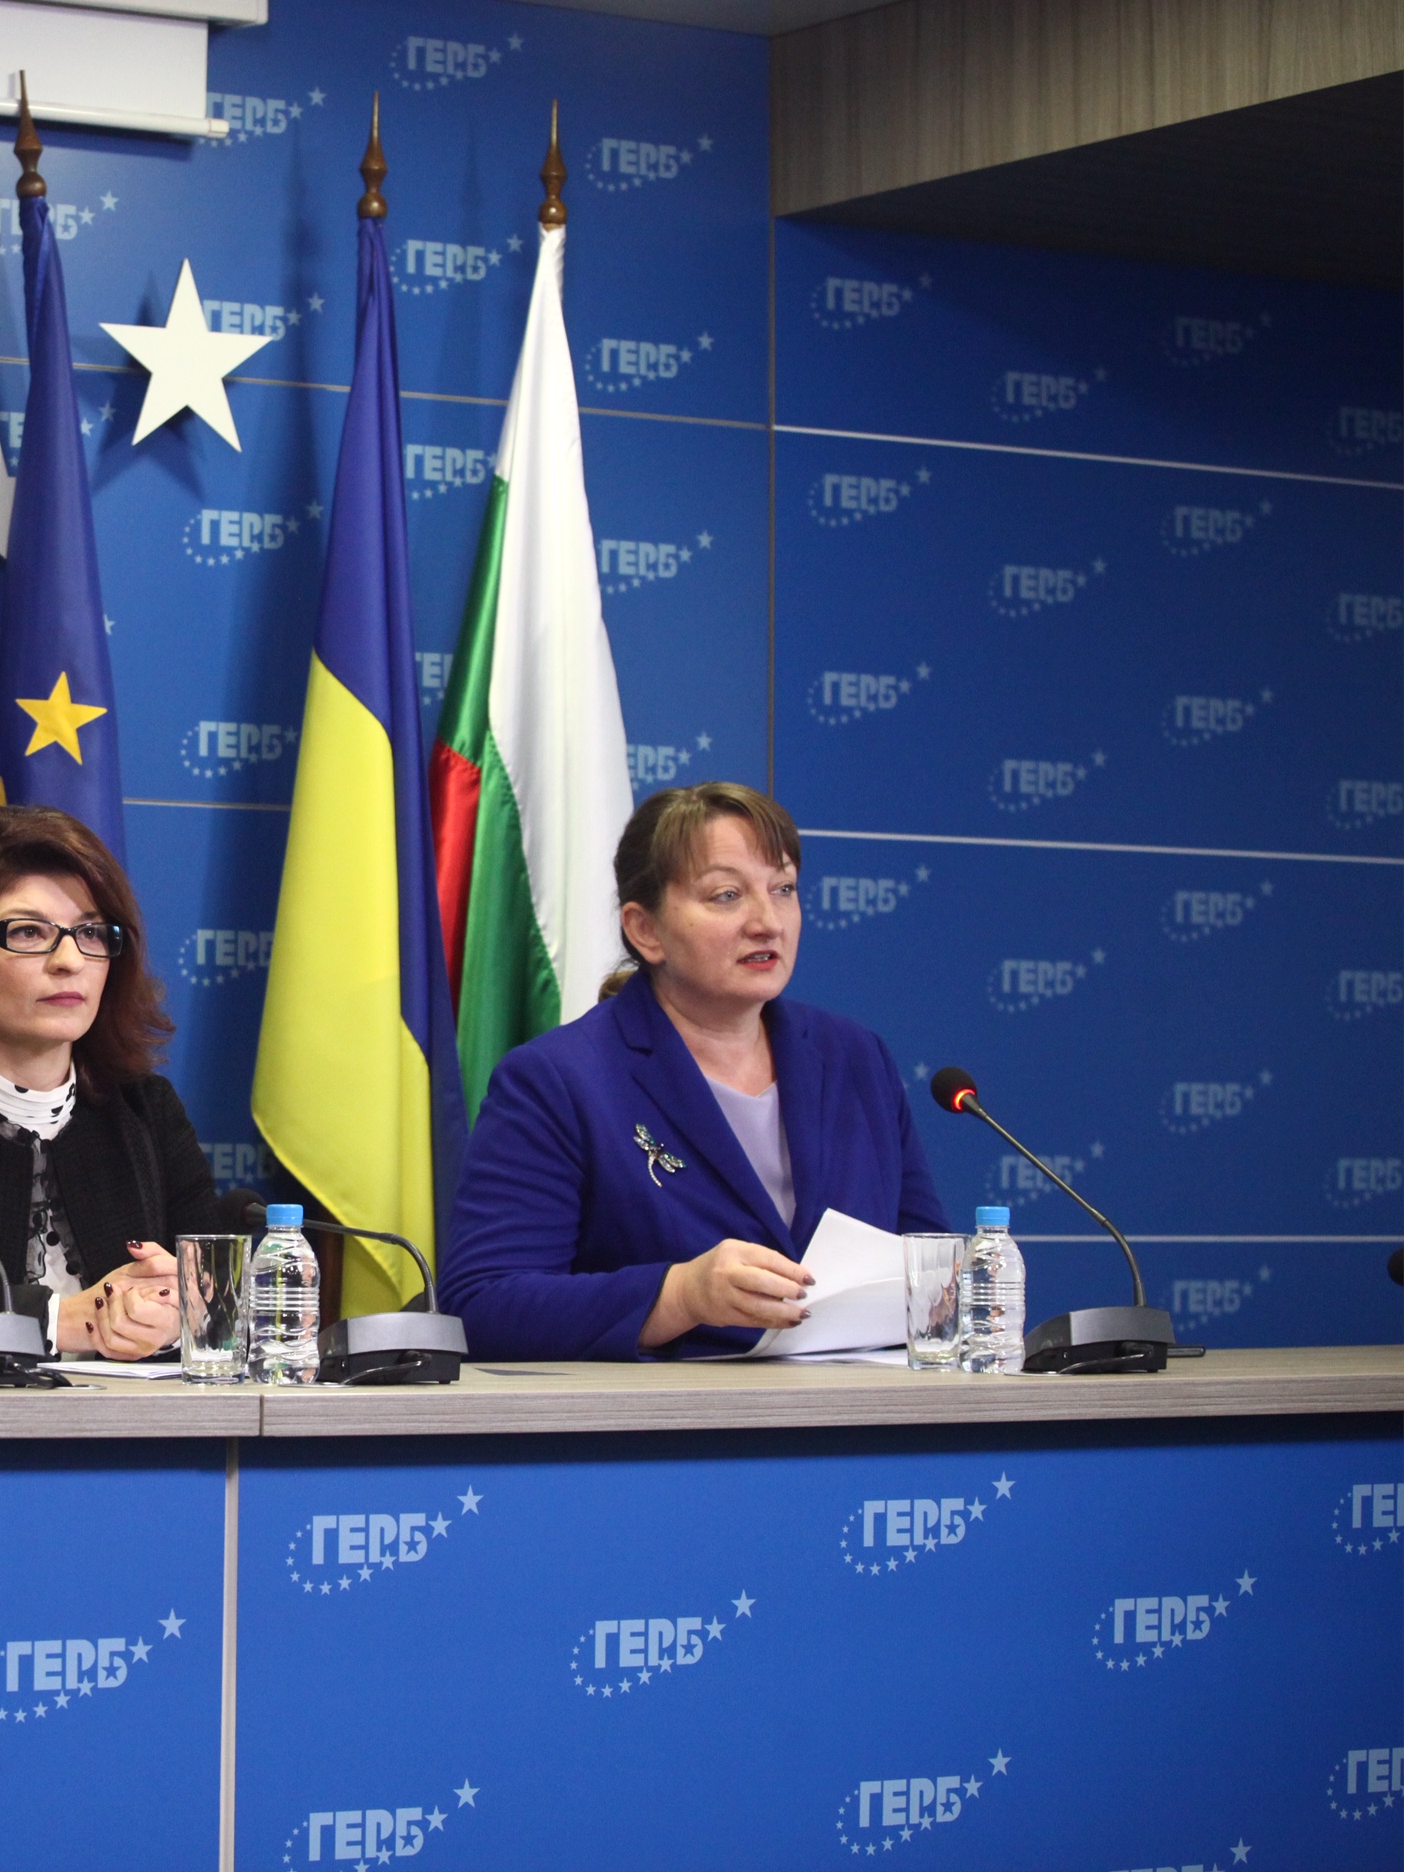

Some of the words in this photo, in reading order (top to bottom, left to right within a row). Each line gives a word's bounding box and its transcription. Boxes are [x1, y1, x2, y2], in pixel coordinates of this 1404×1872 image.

[407, 36, 488, 78] ГЕРБ
[602, 138, 678, 179] ГЕРБ
[407, 239, 486, 282] ГЕРБ
[827, 277, 900, 315] ГЕРБ
[601, 339, 678, 379] ГЕРБ
[1006, 372, 1076, 409] ГЕРБ
[406, 444, 486, 486] ГЕРБ
[824, 474, 897, 512] ГЕРБ
[200, 509, 284, 550] ГЕРБ
[1175, 506, 1243, 543] ГЕРБ
[601, 540, 677, 579] ГЕРБ
[1003, 565, 1074, 602] ГЕРБ
[823, 672, 897, 709] ГЕРБ
[1175, 696, 1243, 732] ГЕРБ
[198, 721, 282, 760] ГЕРБ
[1002, 760, 1074, 796] ГЕРБ
[821, 877, 896, 912] ГЕРБ
[1175, 892, 1243, 926] ГЕРБ
[1001, 960, 1073, 995] ГЕРБ
[1174, 1083, 1242, 1116] ГЕРБ
[1173, 1281, 1241, 1314] ГЕРБ
[312, 1513, 427, 1565] ГЕРБ
[863, 1497, 966, 1547] ГЕРБ
[1114, 1595, 1210, 1643] ГЕРБ
[595, 1617, 704, 1668] ГЕРБ
[5, 1638, 127, 1691] ГЕРБ
[859, 1776, 962, 1828] ГЕРБ
[308, 1807, 424, 1861] ГЕРБ
